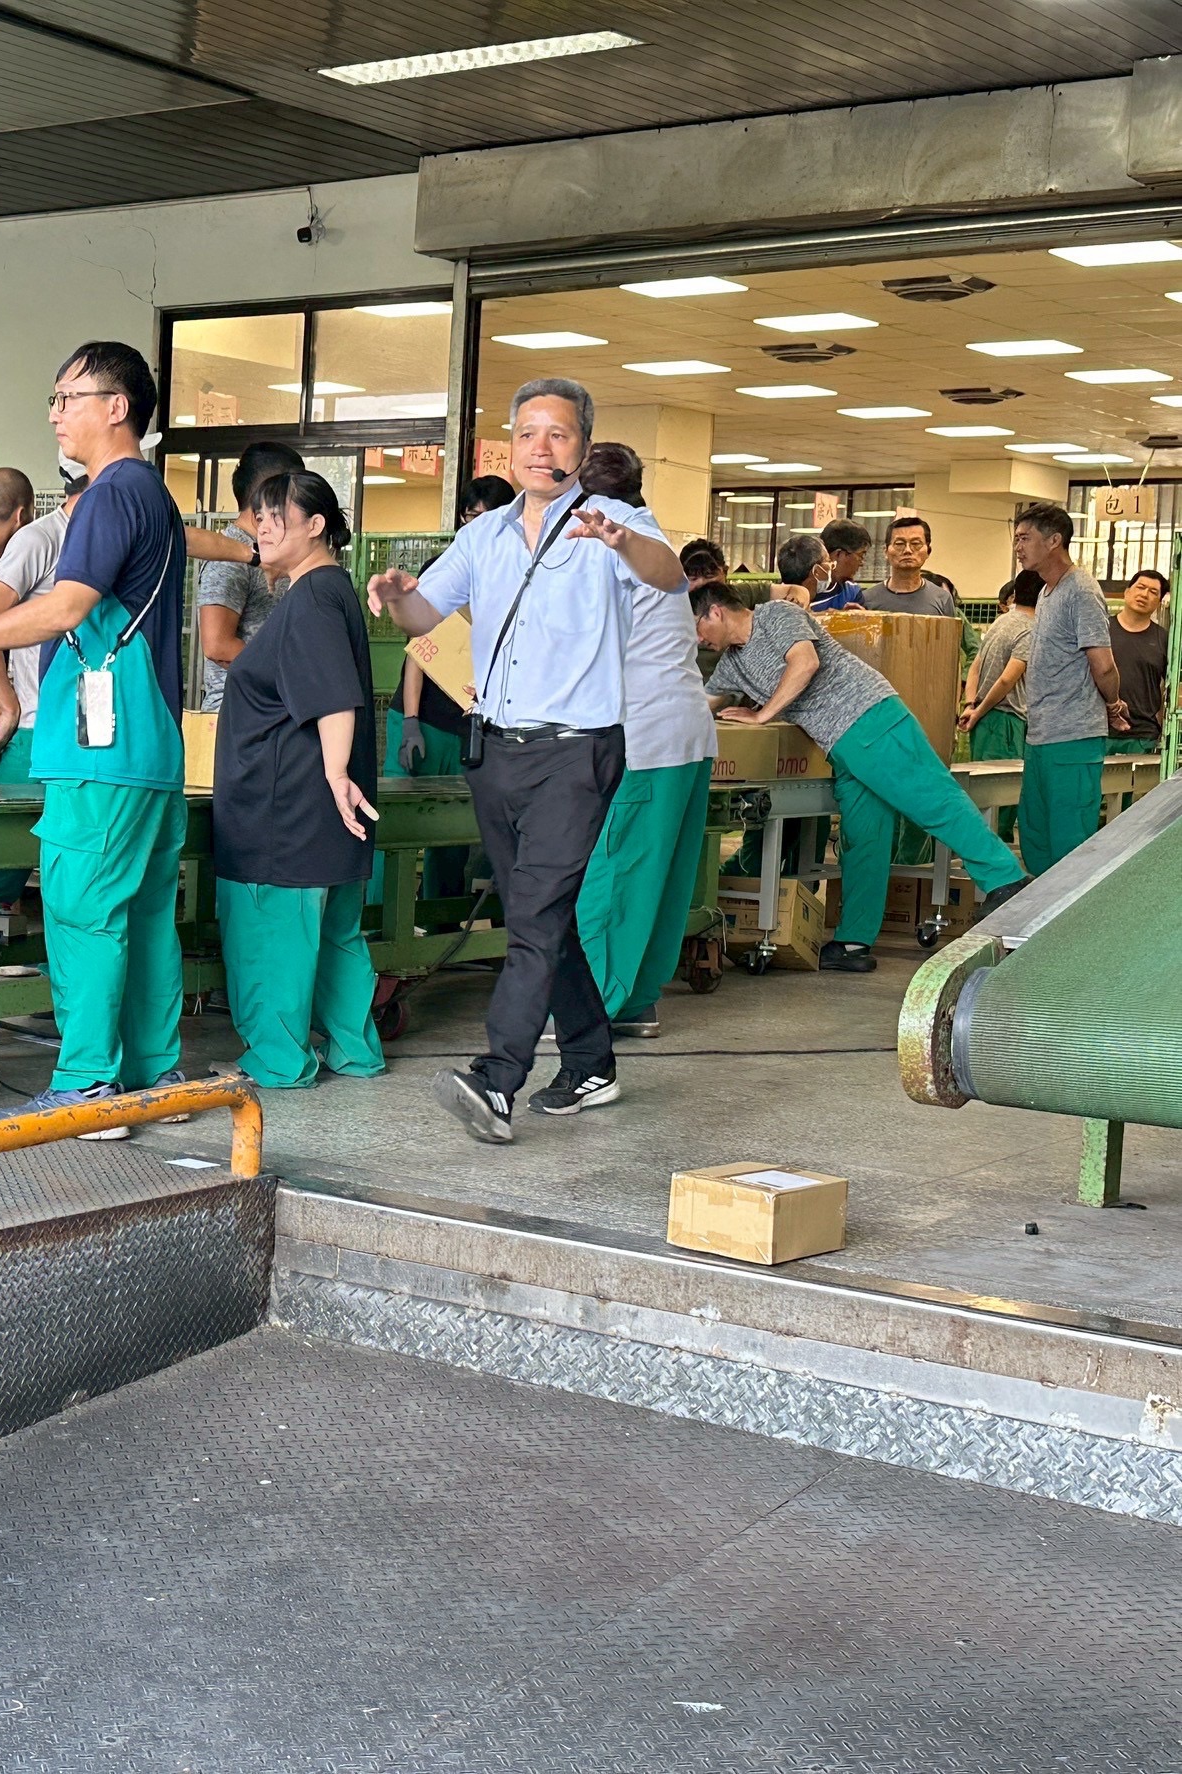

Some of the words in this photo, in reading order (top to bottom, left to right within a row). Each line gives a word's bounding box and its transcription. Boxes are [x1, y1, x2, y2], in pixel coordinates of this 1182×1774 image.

[483, 449, 508, 472] 宗六
[1106, 495, 1124, 516] 包
[1134, 495, 1141, 515] 1
[711, 760, 736, 776] omo
[777, 757, 808, 775] omo
